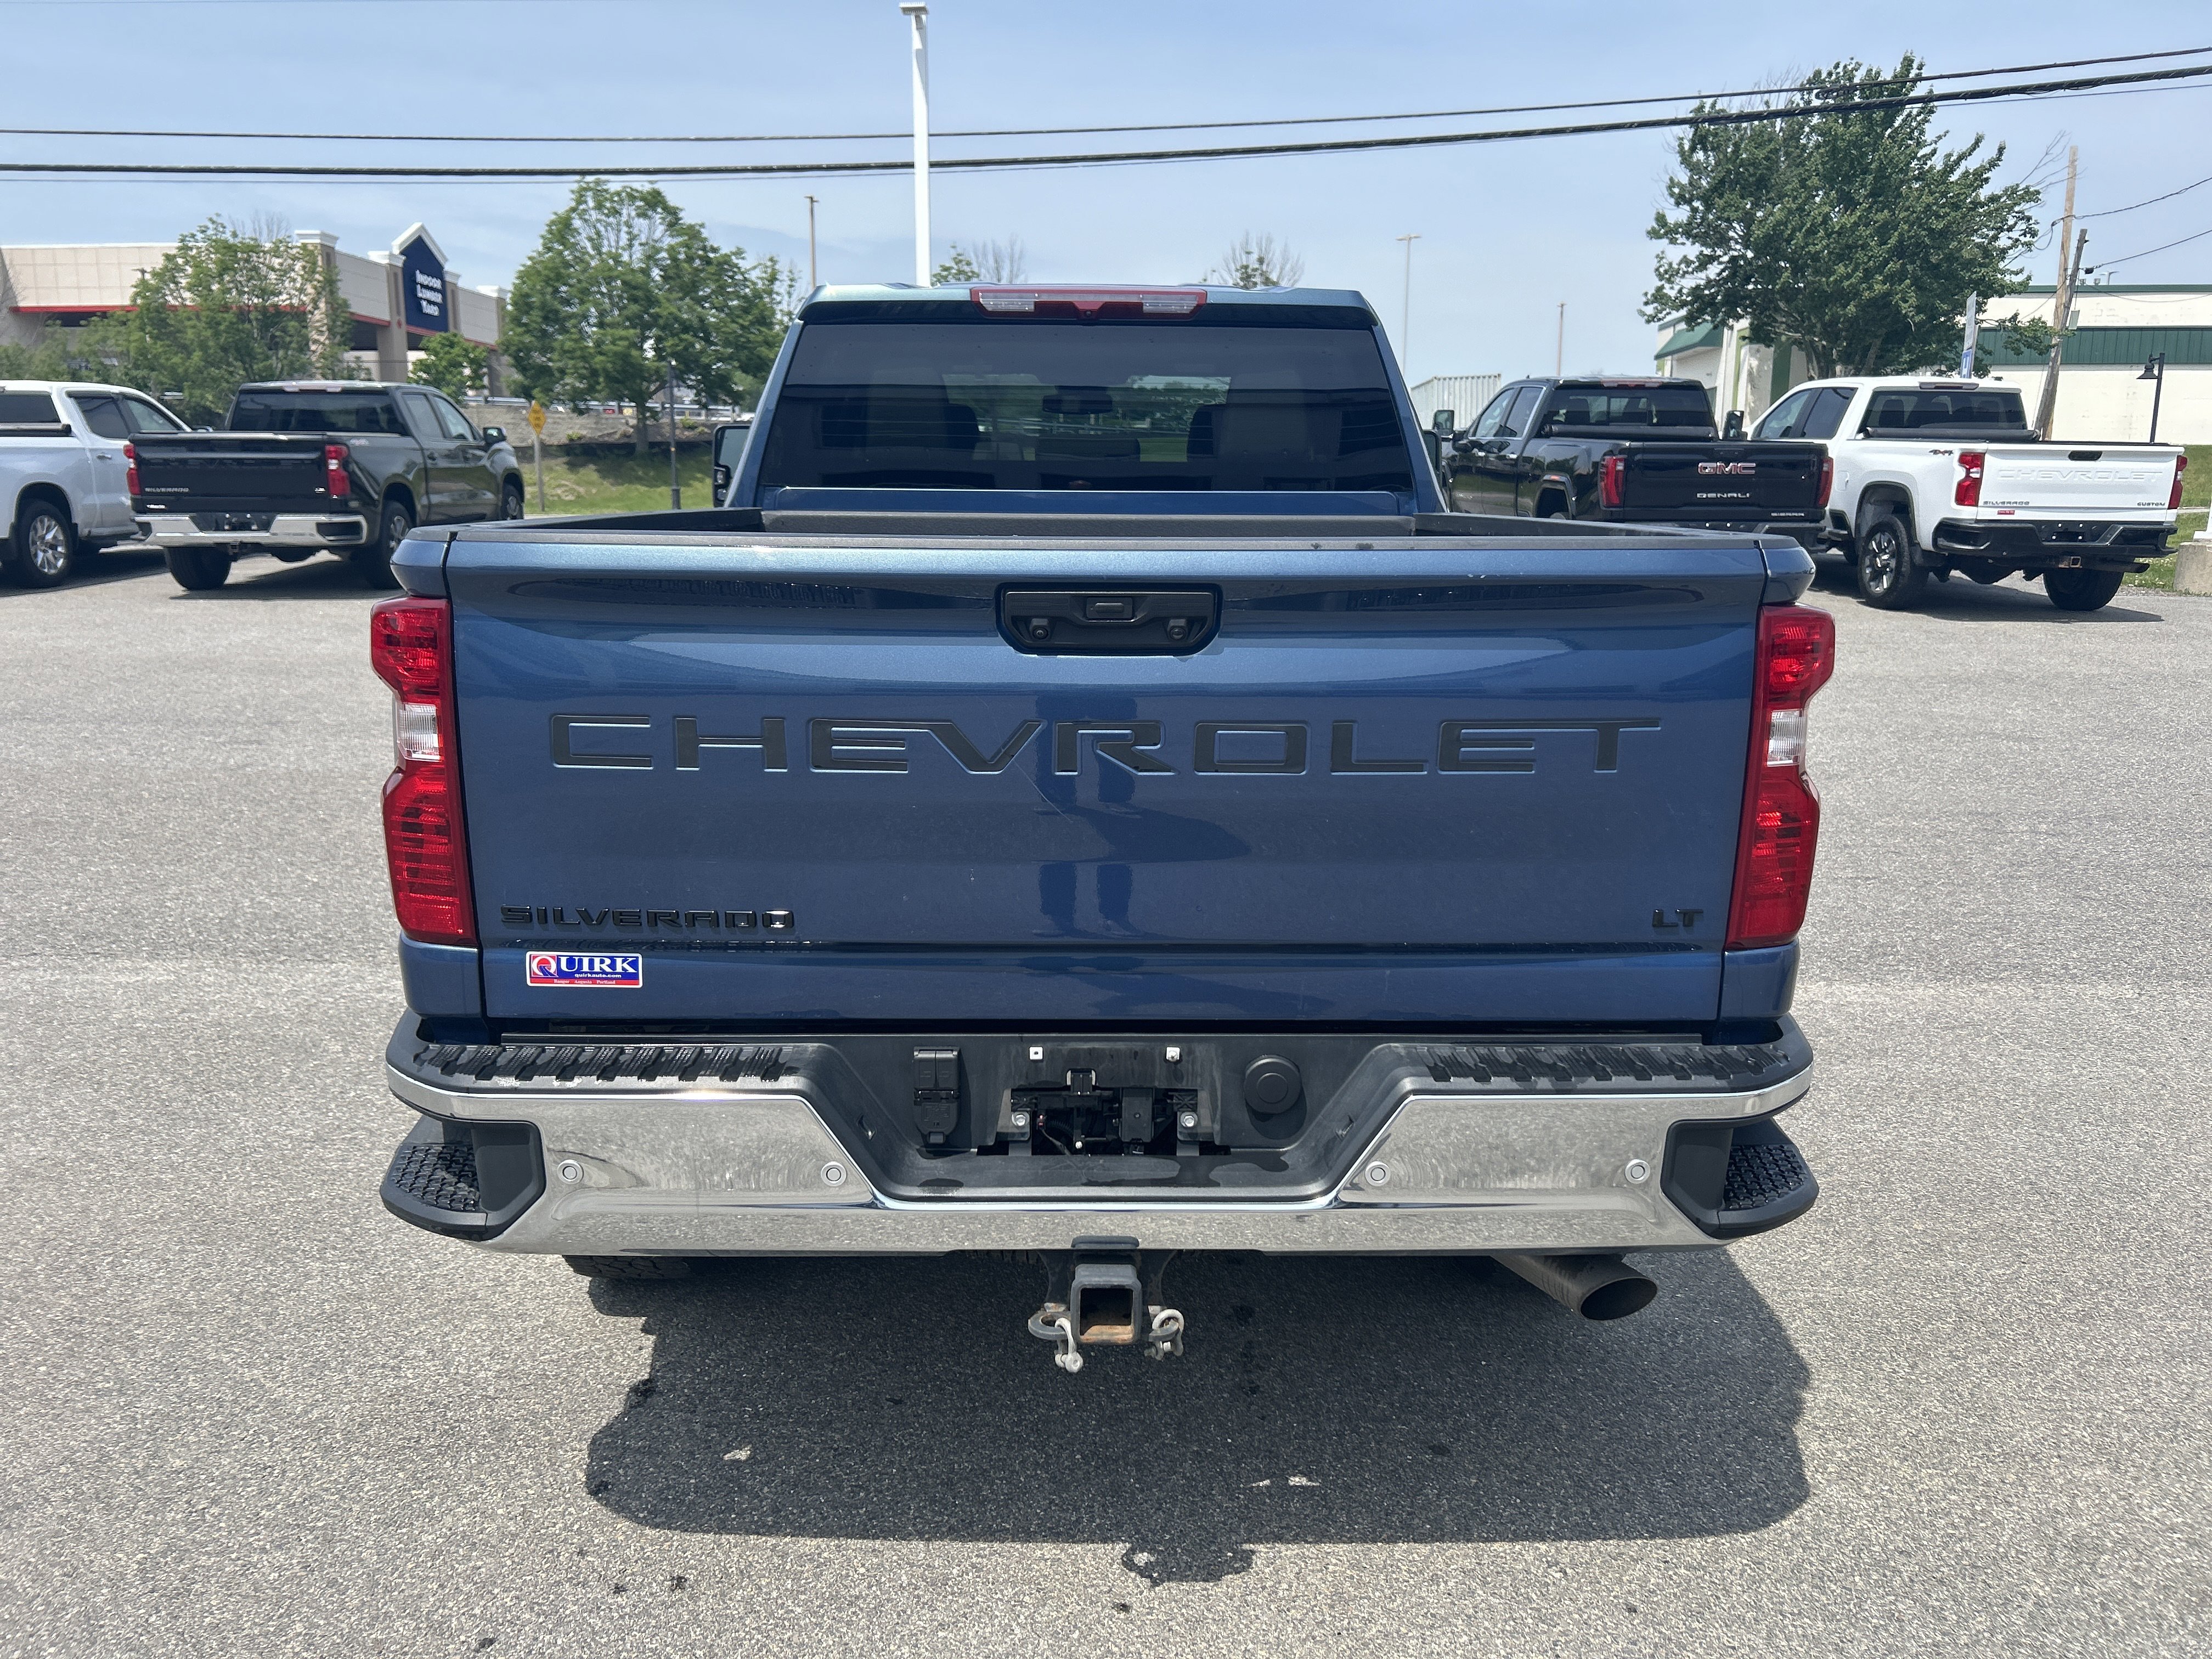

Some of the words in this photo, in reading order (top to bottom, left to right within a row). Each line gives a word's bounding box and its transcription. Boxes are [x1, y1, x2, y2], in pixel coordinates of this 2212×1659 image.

[1698, 462, 1756, 475] GMC
[1997, 469, 2163, 482] CHEVROLET
[551, 714, 1662, 775] CHEVROLET
[500, 905, 795, 929] SILVERADO
[1652, 909, 1704, 928] LT
[532, 956, 637, 977] QUIRK
